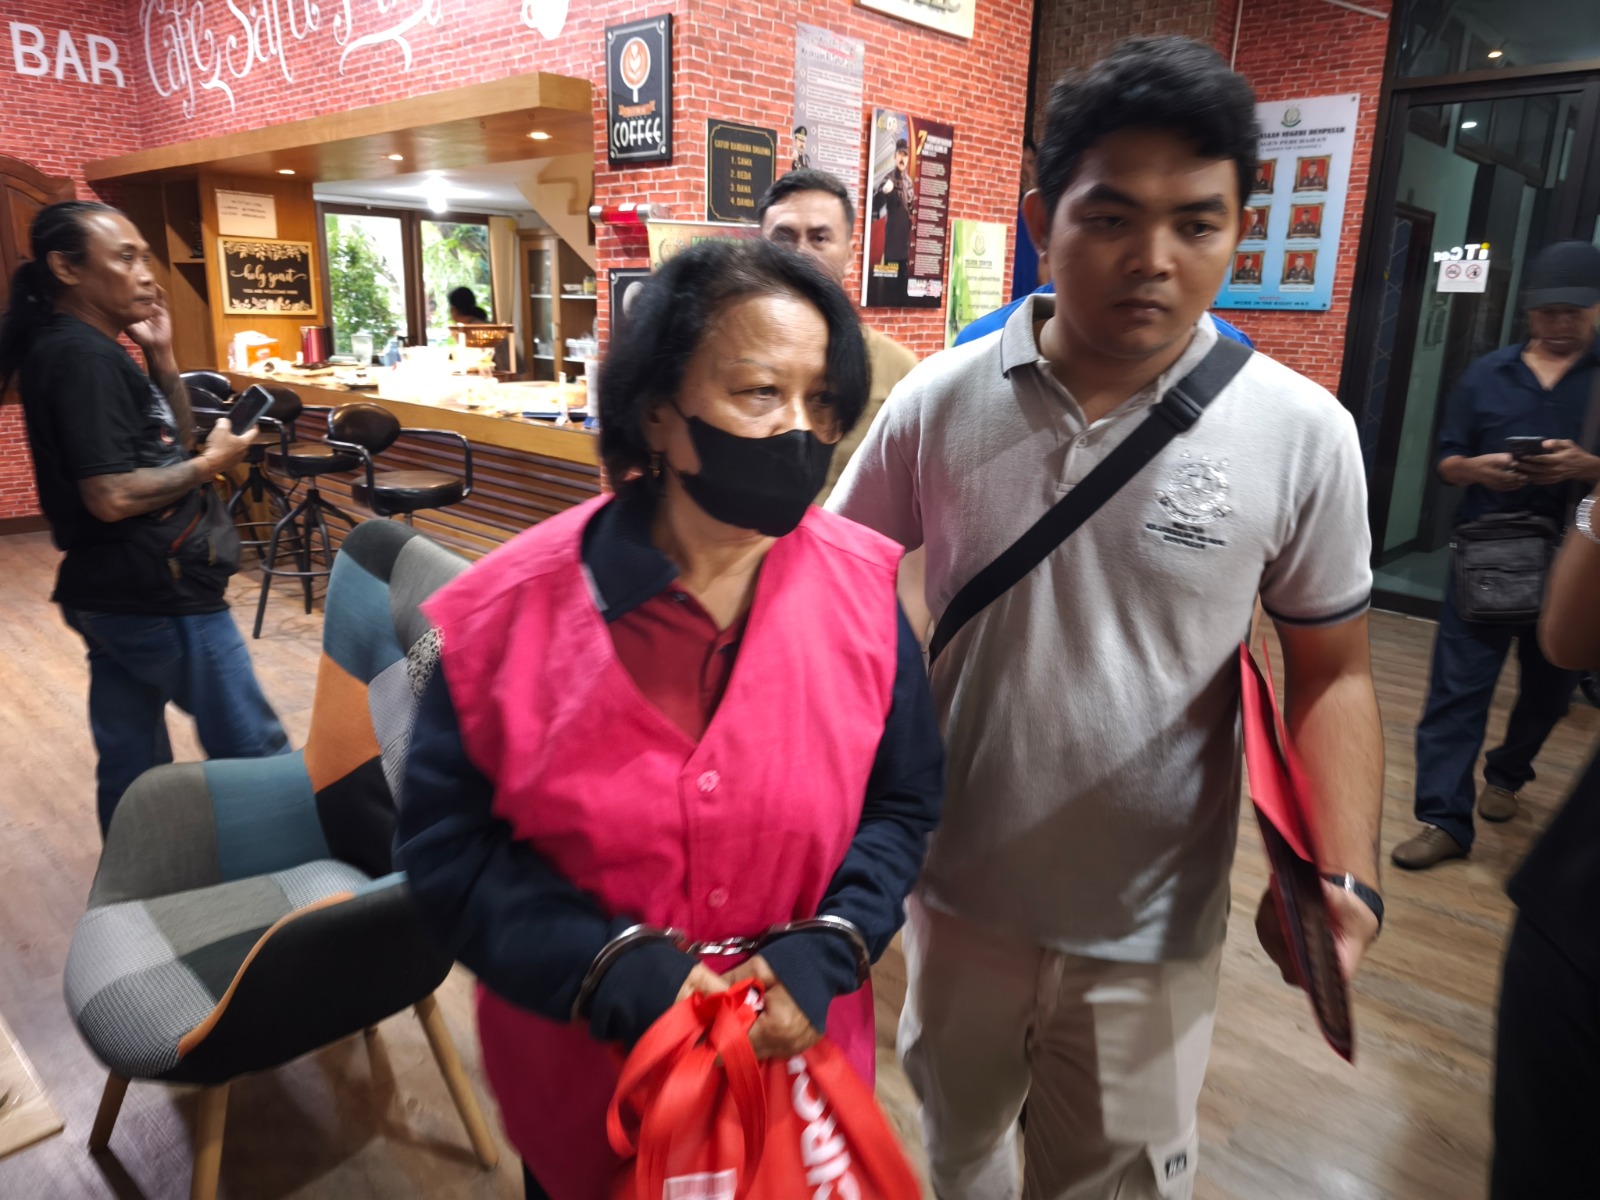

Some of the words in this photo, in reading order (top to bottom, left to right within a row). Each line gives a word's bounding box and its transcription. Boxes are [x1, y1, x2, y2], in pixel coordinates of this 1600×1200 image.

[9, 22, 125, 88] BAR
[613, 117, 661, 147] COFFEE
[917, 129, 927, 155] 7
